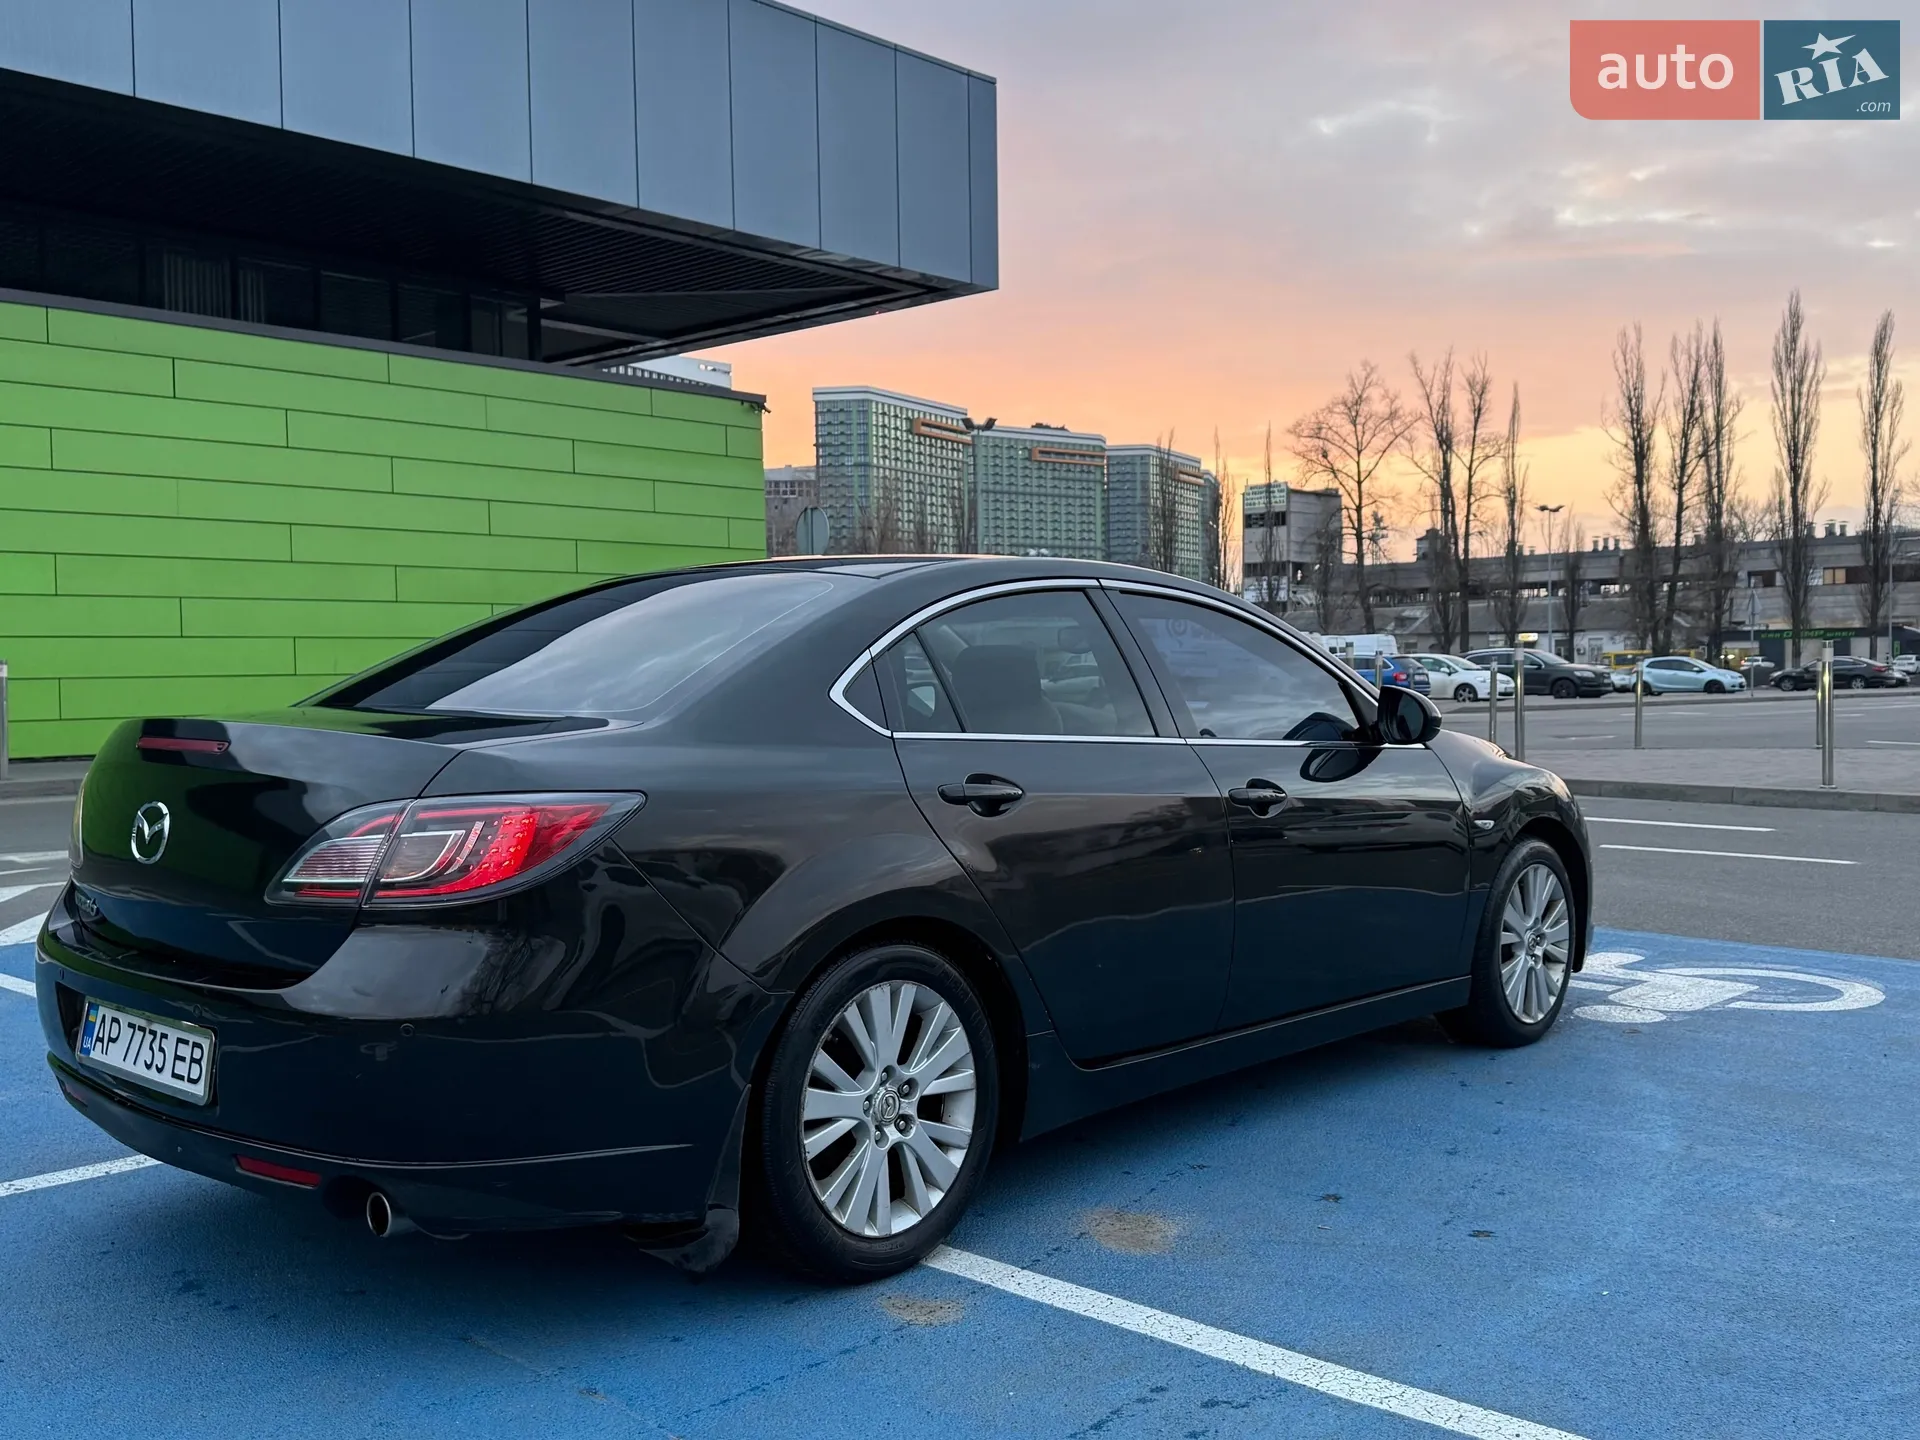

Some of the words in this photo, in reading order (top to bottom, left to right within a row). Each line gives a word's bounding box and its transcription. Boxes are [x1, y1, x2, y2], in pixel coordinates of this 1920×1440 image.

[82, 1035, 92, 1050] UA
[92, 1013, 121, 1056] AP
[122, 1021, 168, 1074] 7735
[171, 1036, 204, 1085] EB
